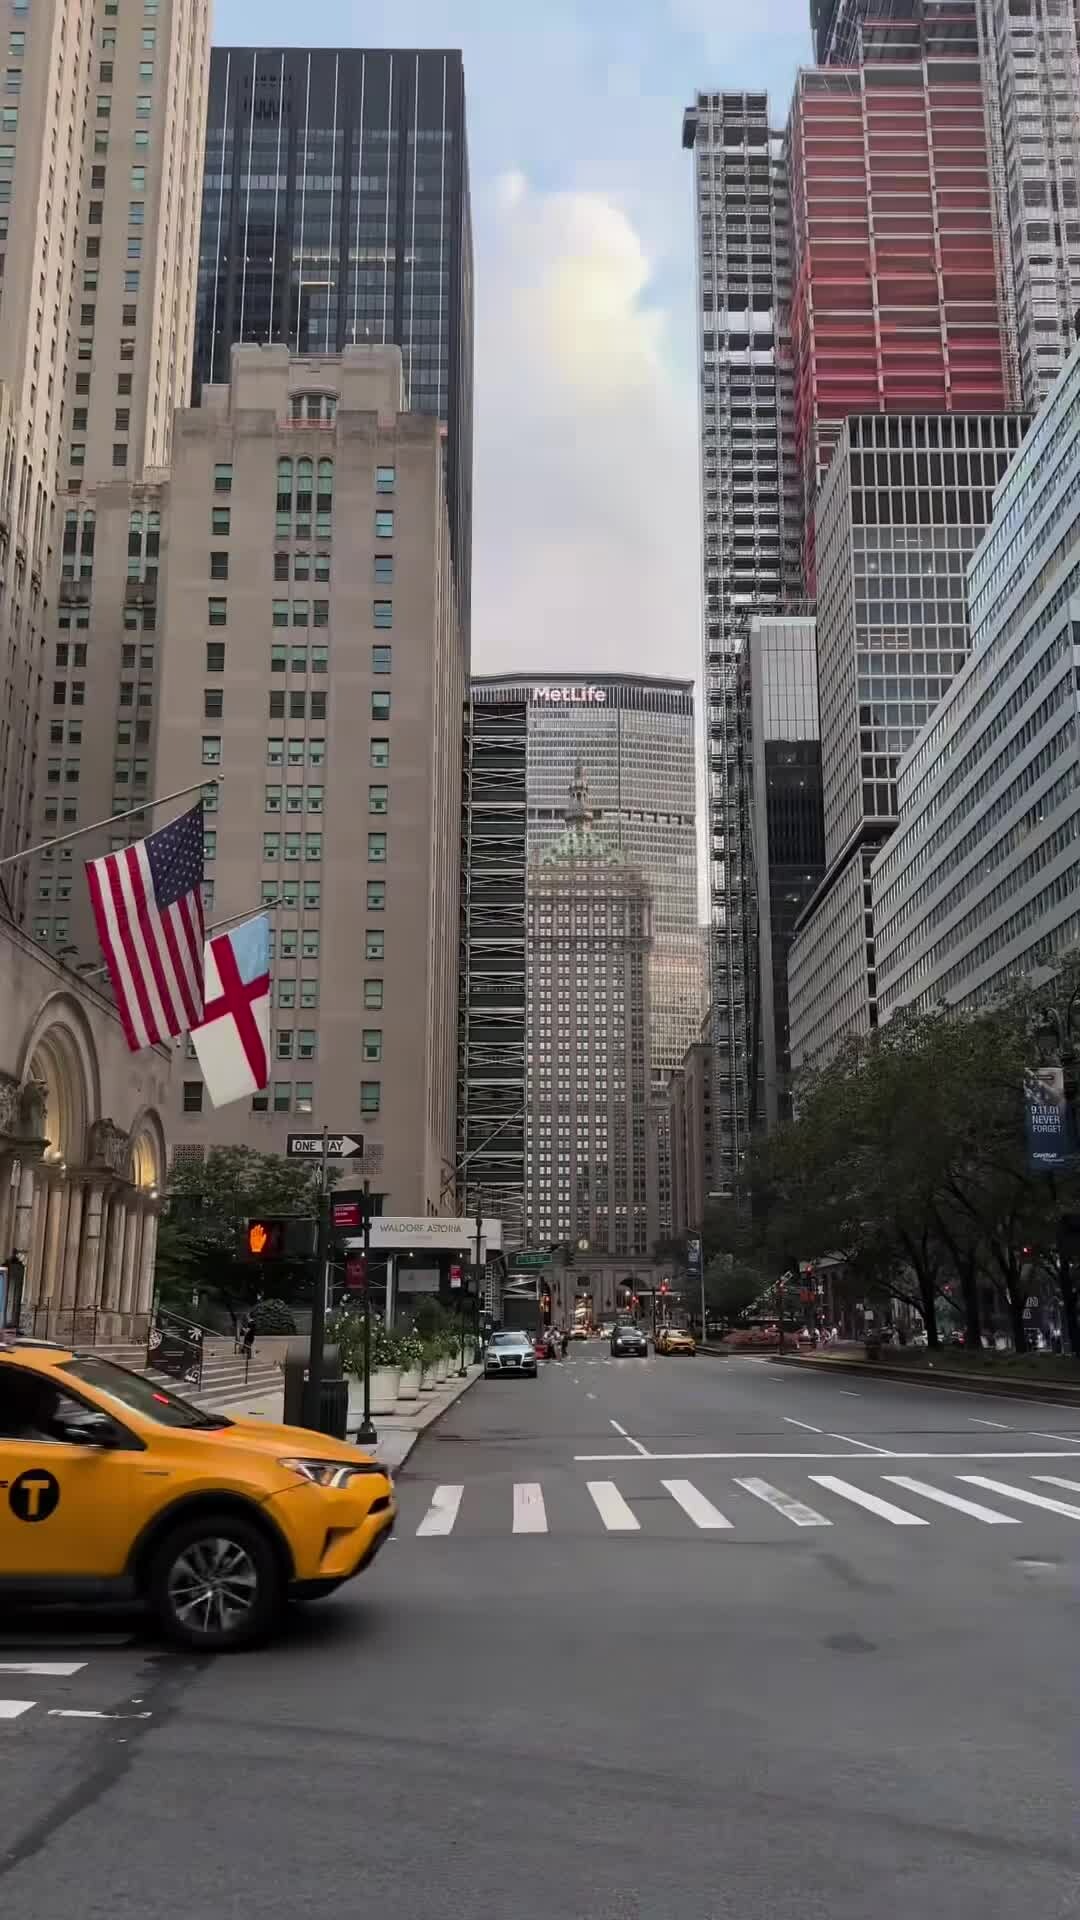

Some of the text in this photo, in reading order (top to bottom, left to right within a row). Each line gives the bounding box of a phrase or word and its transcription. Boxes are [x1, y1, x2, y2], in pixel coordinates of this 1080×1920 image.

[532, 686, 607, 702] MetLife
[1031, 1105, 1060, 1115] 9.11.01
[1032, 1115, 1061, 1125] NEVER
[1033, 1125, 1062, 1133] FORGET
[295, 1140, 317, 1151] ONE
[380, 1223, 463, 1233] WALDORF ASTORIA
[21, 1479, 50, 1516] T
